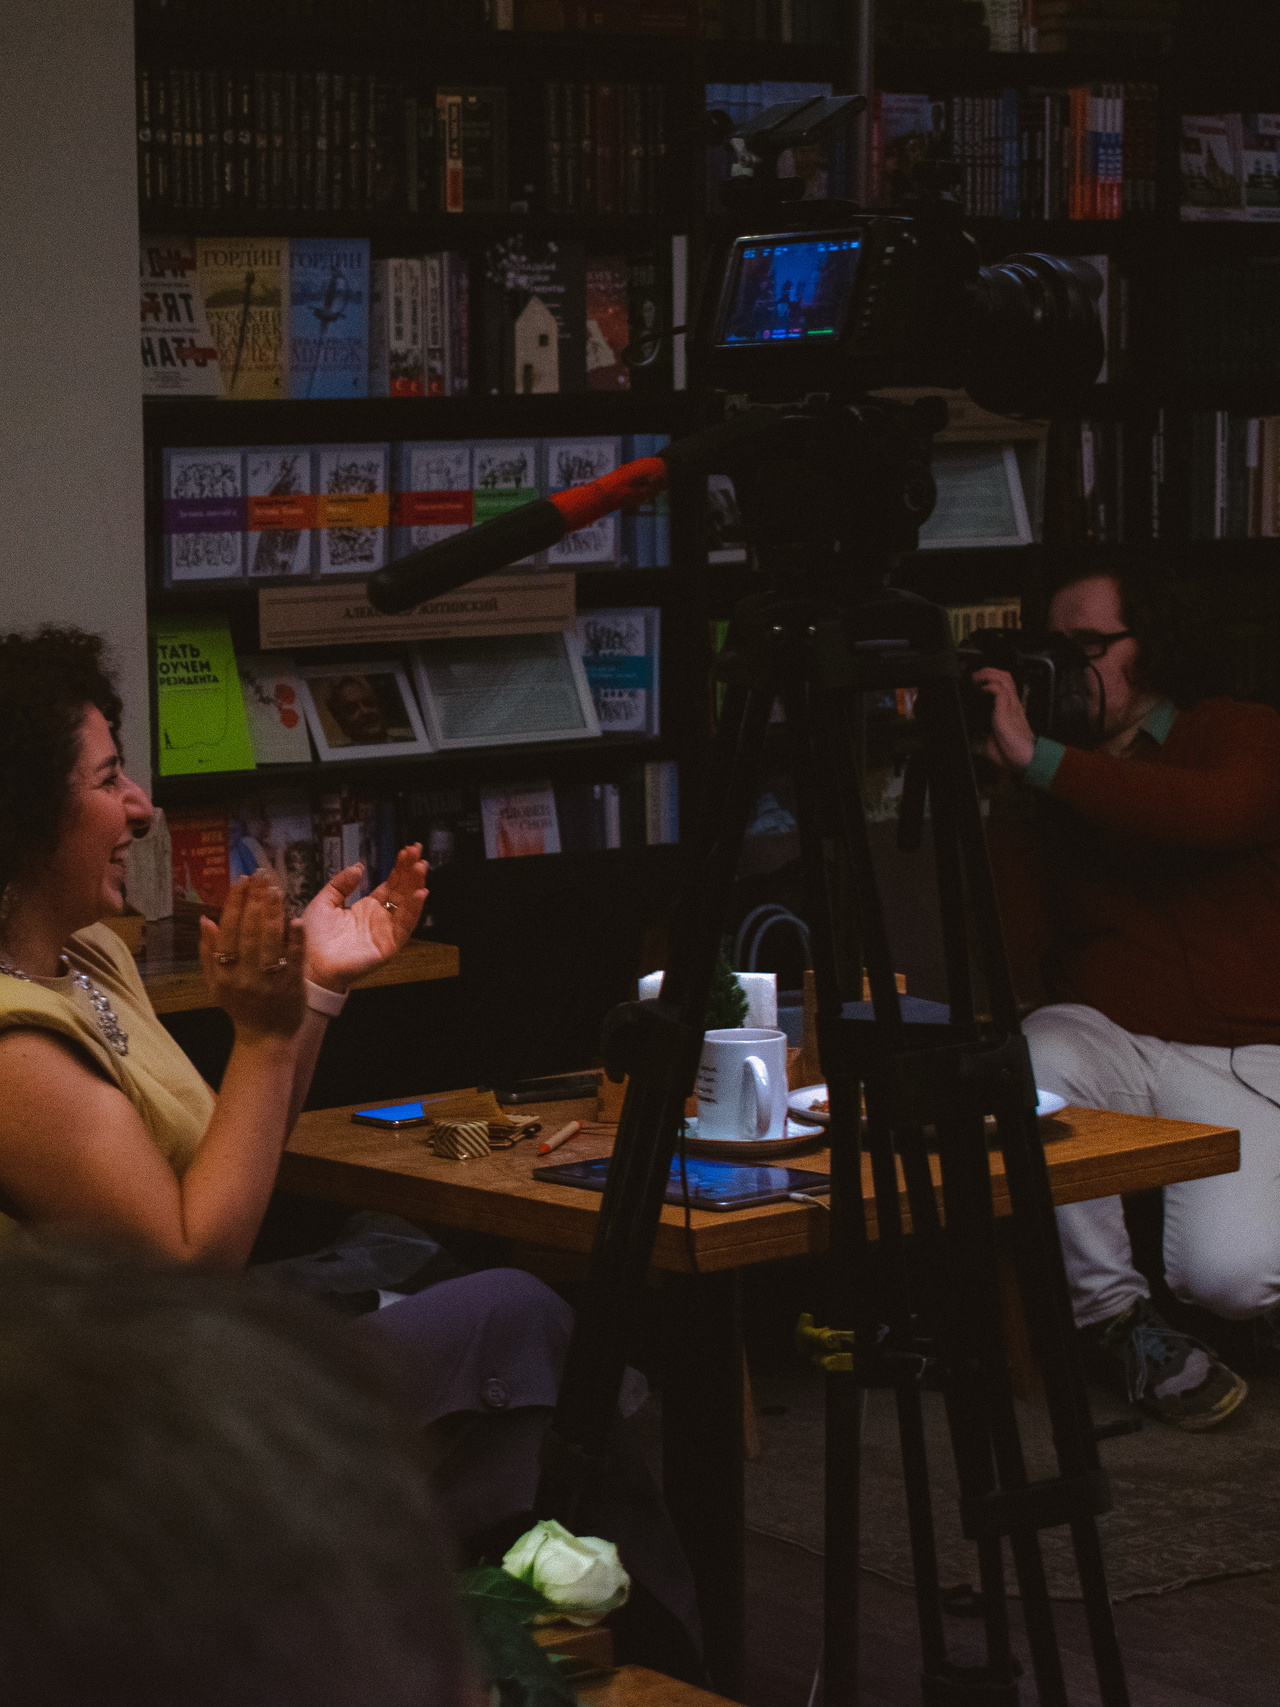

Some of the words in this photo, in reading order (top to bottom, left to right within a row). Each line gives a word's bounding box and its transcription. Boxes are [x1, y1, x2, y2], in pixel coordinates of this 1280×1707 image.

[203, 250, 281, 269] ГОРДИН
[140, 336, 208, 368] НАТЬ
[159, 643, 201, 659] ТАТЬ
[159, 660, 211, 674] ОУЧЕМ
[159, 674, 219, 686] РЕЗИДЕНТА
